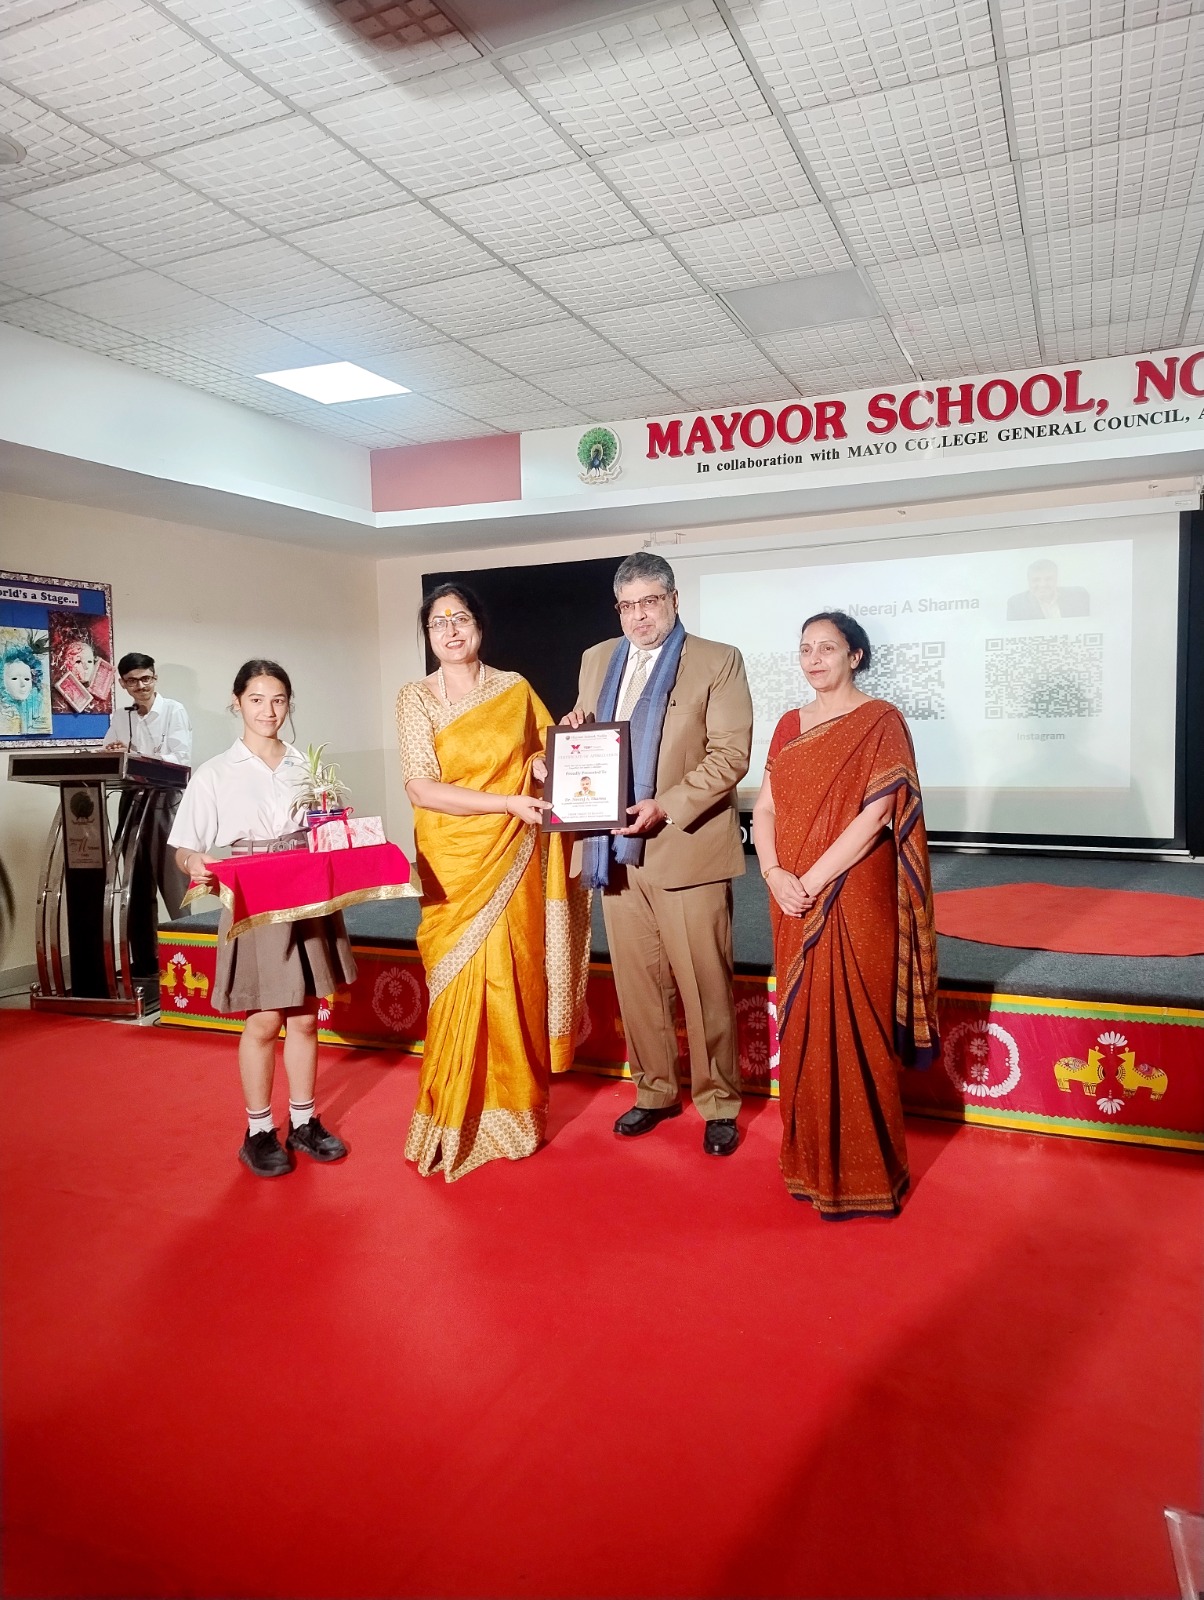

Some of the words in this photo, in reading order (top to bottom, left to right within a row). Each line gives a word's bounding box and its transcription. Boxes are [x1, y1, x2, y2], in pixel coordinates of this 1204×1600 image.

[646, 400, 848, 459] MAYOOR
[866, 369, 1110, 435] SCHOOL,
[697, 462, 710, 473] In
[717, 453, 803, 472] collaboration
[811, 447, 840, 462] with
[848, 441, 897, 458] MAYO
[998, 421, 1086, 441] GENERAL
[1094, 408, 1190, 431] COUNCIL,
[848, 602, 897, 617] Neeraj
[902, 600, 913, 613] A
[918, 598, 980, 612] Sharma
[1017, 733, 1065, 741] Instagram
